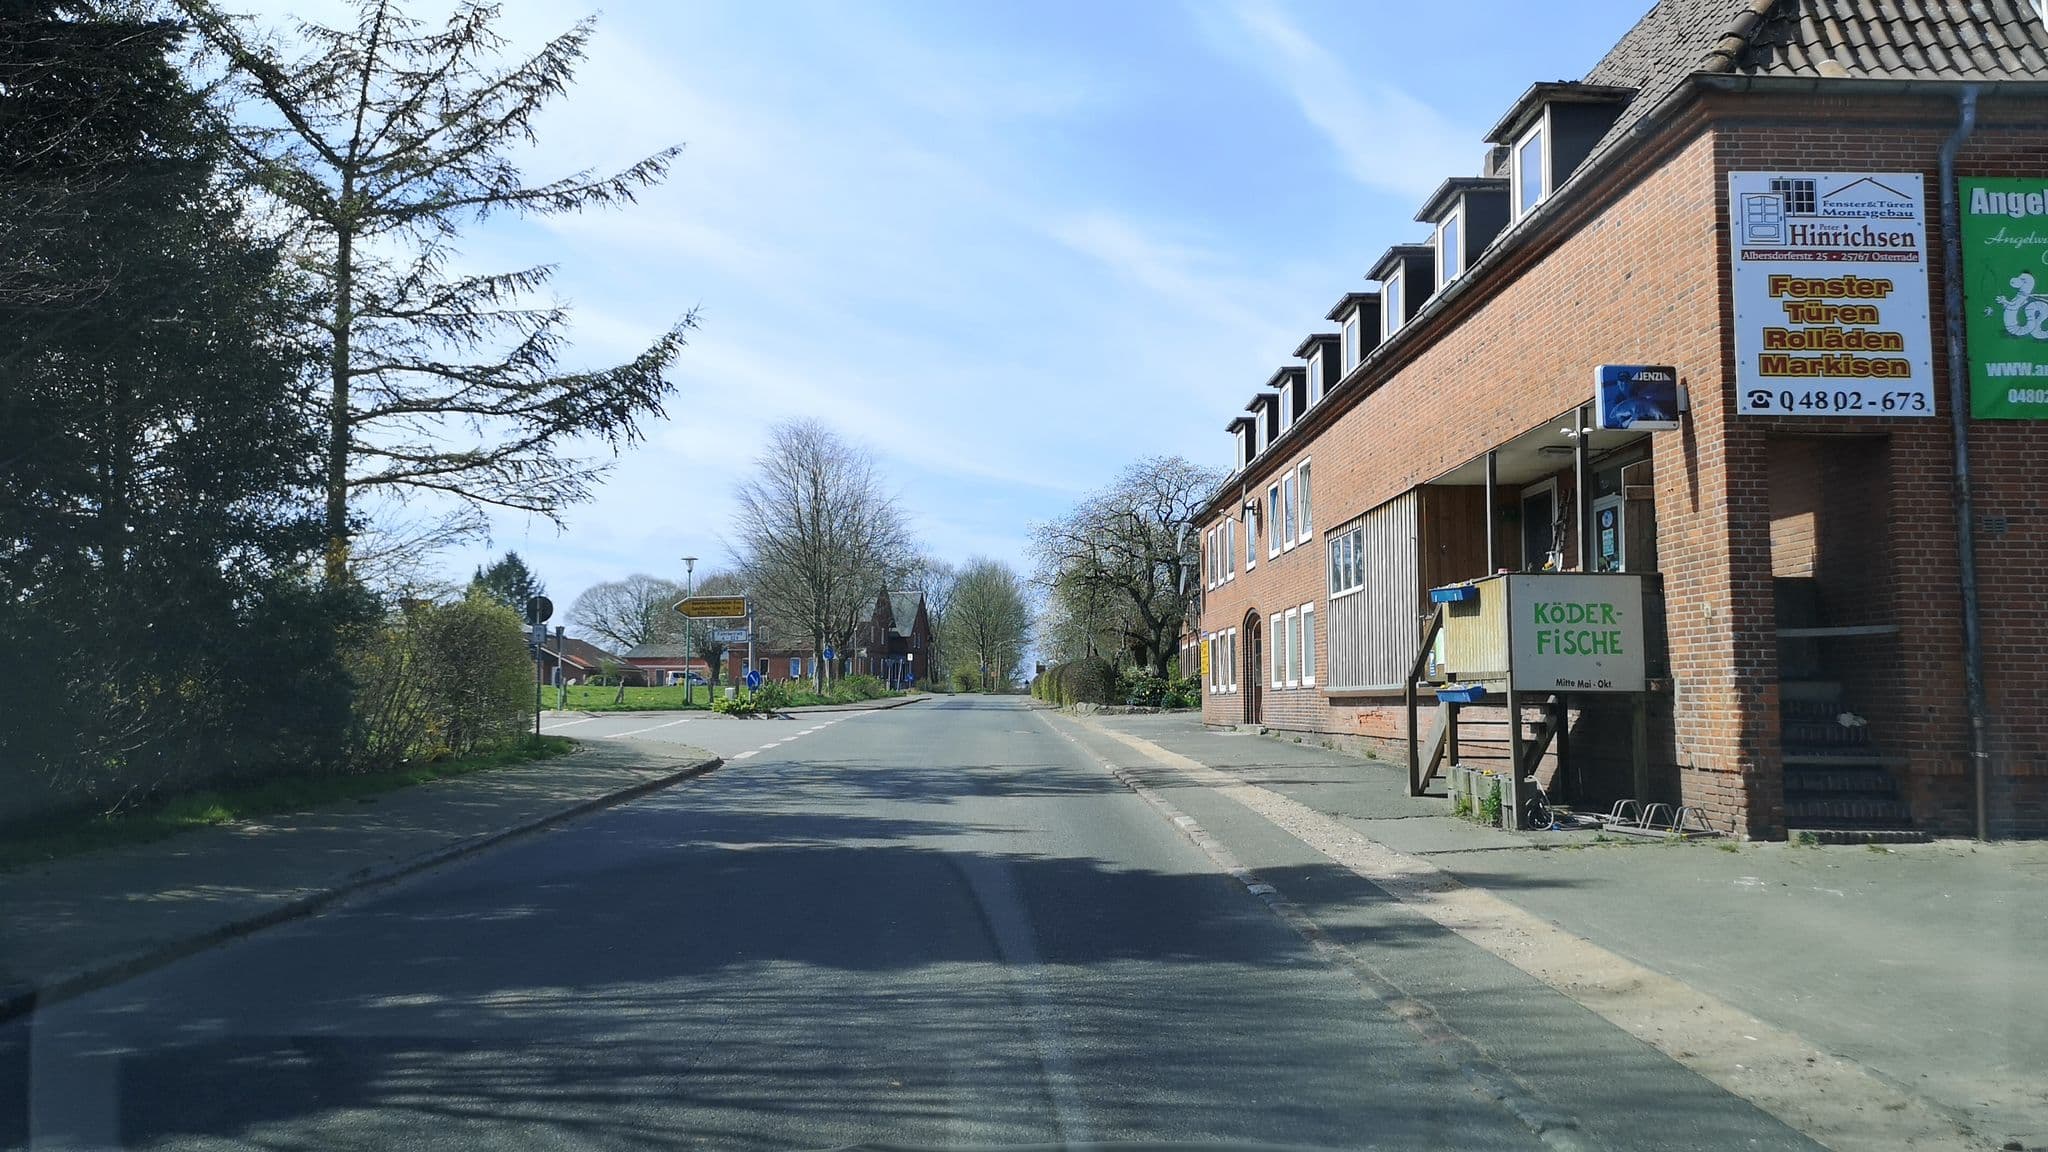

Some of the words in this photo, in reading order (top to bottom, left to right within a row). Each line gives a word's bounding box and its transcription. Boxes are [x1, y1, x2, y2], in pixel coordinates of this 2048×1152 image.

[1823, 200, 1914, 209] Fenster&Türen
[1822, 208, 1914, 219] Montagebau
[1789, 223, 1916, 248] Hinrichsen
[1819, 223, 1839, 231] Peter
[1815, 252, 1828, 261] 25
[1841, 252, 1869, 261] 25767
[1871, 252, 1918, 262] Osterrade
[1768, 275, 1893, 298] Fenster
[1783, 300, 1880, 324] Türen
[1763, 327, 1904, 351] Rolläden
[1759, 353, 1911, 378] Markisen
[1640, 371, 1663, 381] JENZI
[1534, 602, 1623, 625] KÖDER-
[1556, 678, 1575, 687] Mitte
[1577, 679, 1592, 688] Mai
